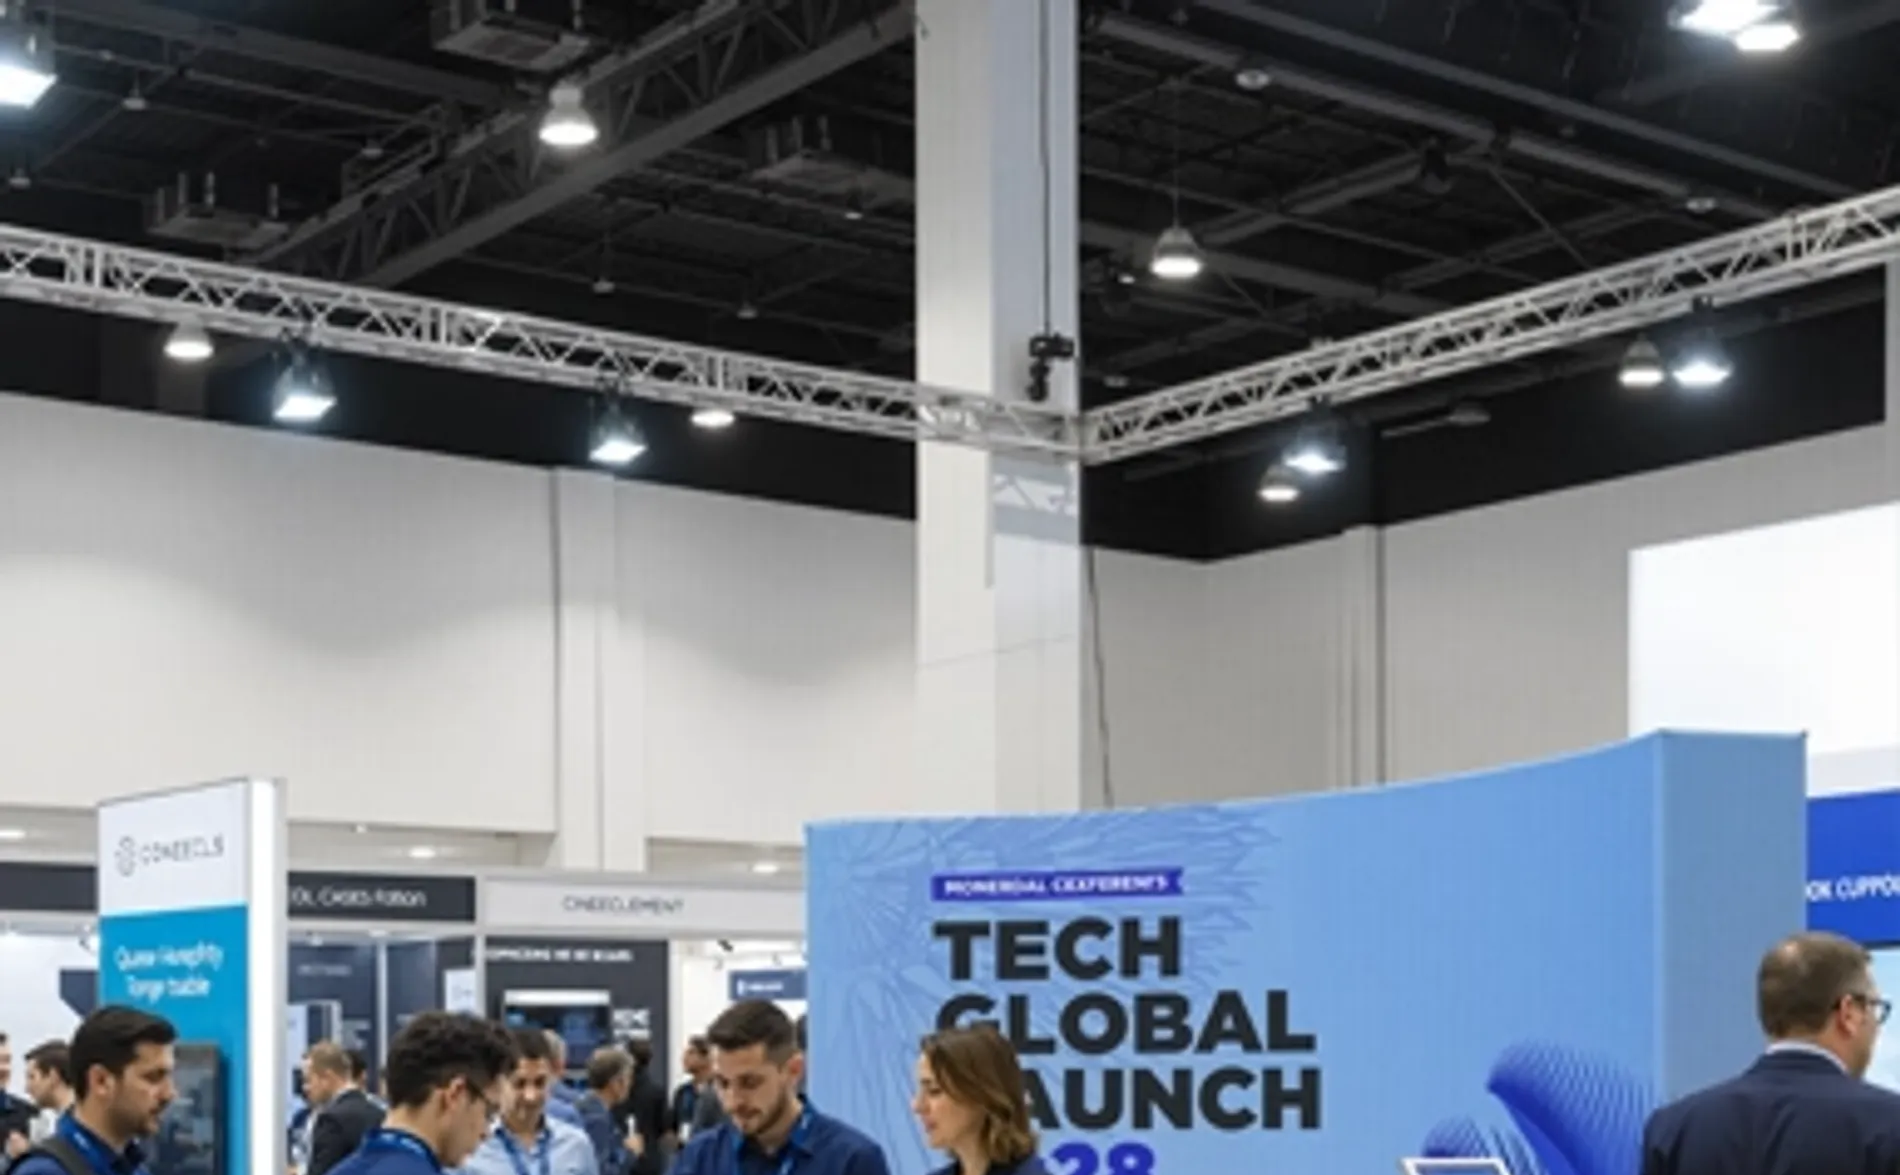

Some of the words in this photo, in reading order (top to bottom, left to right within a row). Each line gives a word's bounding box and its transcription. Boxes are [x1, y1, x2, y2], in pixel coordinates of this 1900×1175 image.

[933, 916, 1182, 980] TECH
[937, 990, 1316, 1055] GLOBAL
[1022, 1067, 1321, 1131] AUNCH
